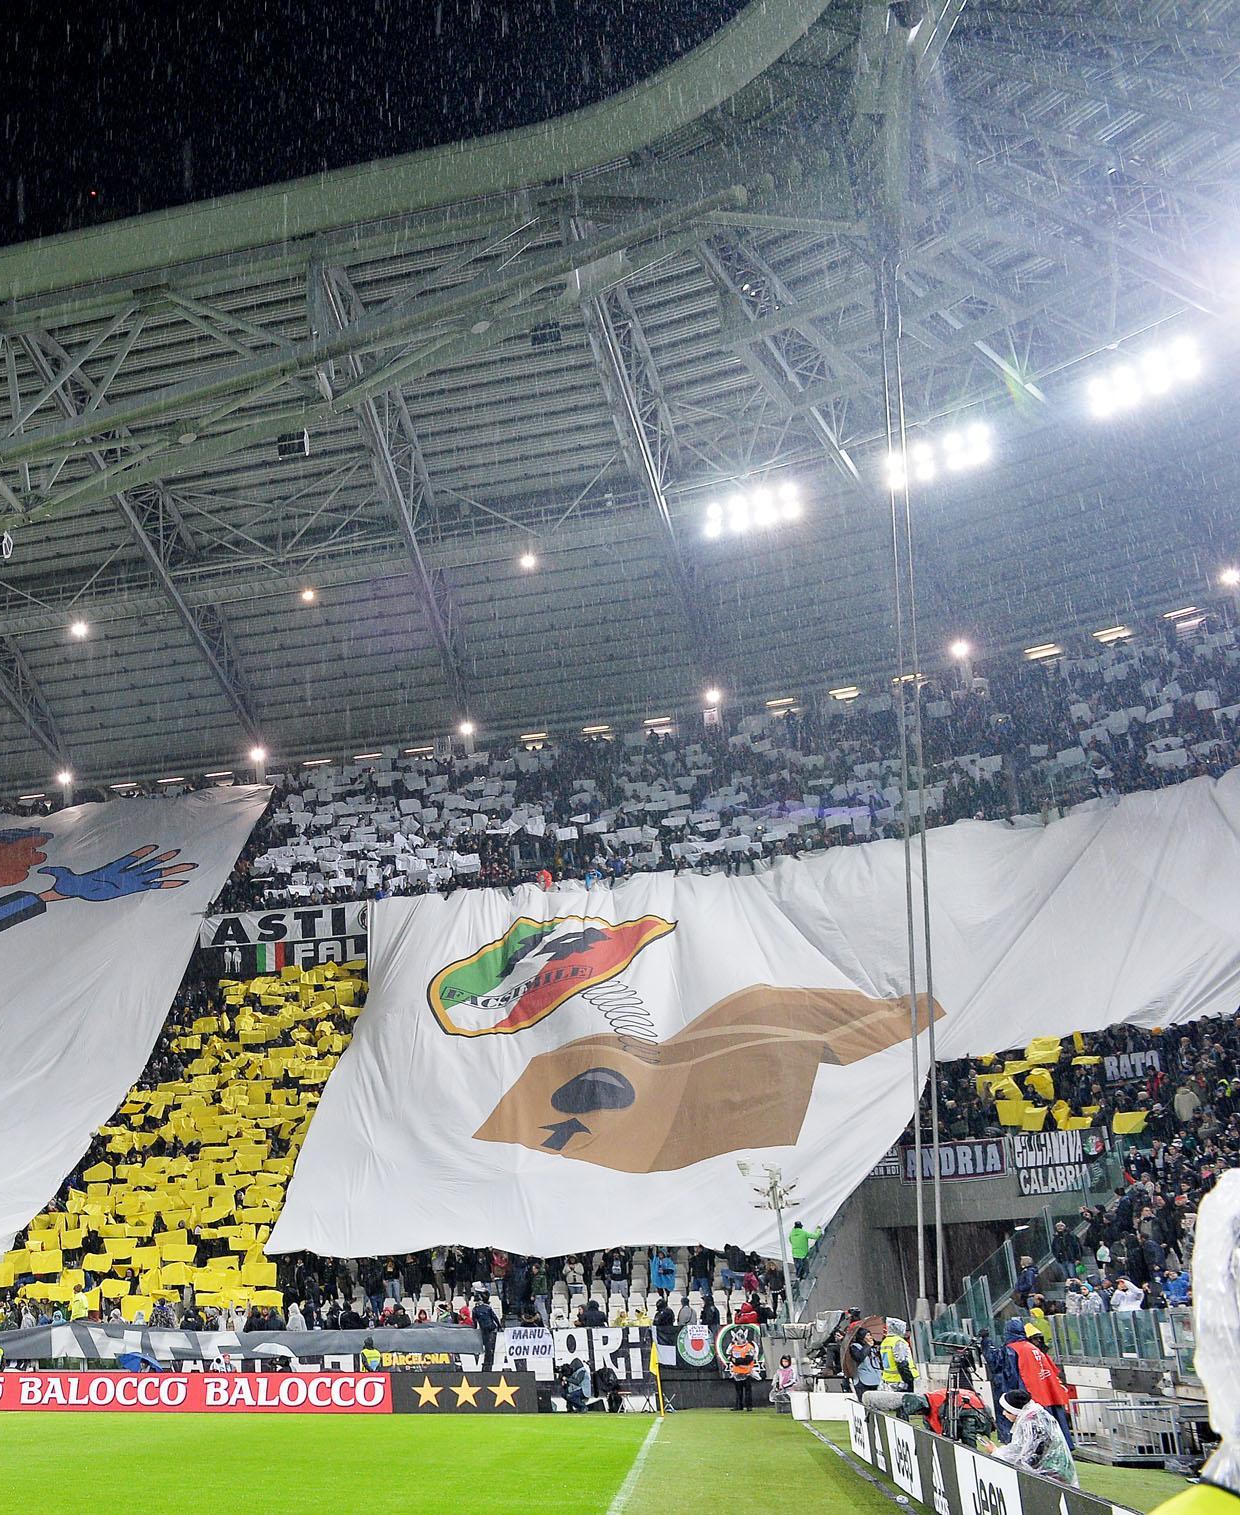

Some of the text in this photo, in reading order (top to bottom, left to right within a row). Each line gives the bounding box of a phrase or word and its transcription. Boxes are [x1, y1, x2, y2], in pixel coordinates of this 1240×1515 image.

[210, 907, 348, 946] ASTI
[445, 966, 589, 1008] FACSIMILE
[906, 1143, 1002, 1178] ANDRIA
[1019, 1164, 1092, 1195] CALABRIA
[381, 1352, 451, 1367] BARCELONA
[508, 1344, 552, 1356] CON NOI
[19, 1377, 189, 1406] BALOCCO
[204, 1377, 386, 1407] BALOCCO
[892, 1420, 915, 1494] Jeep
